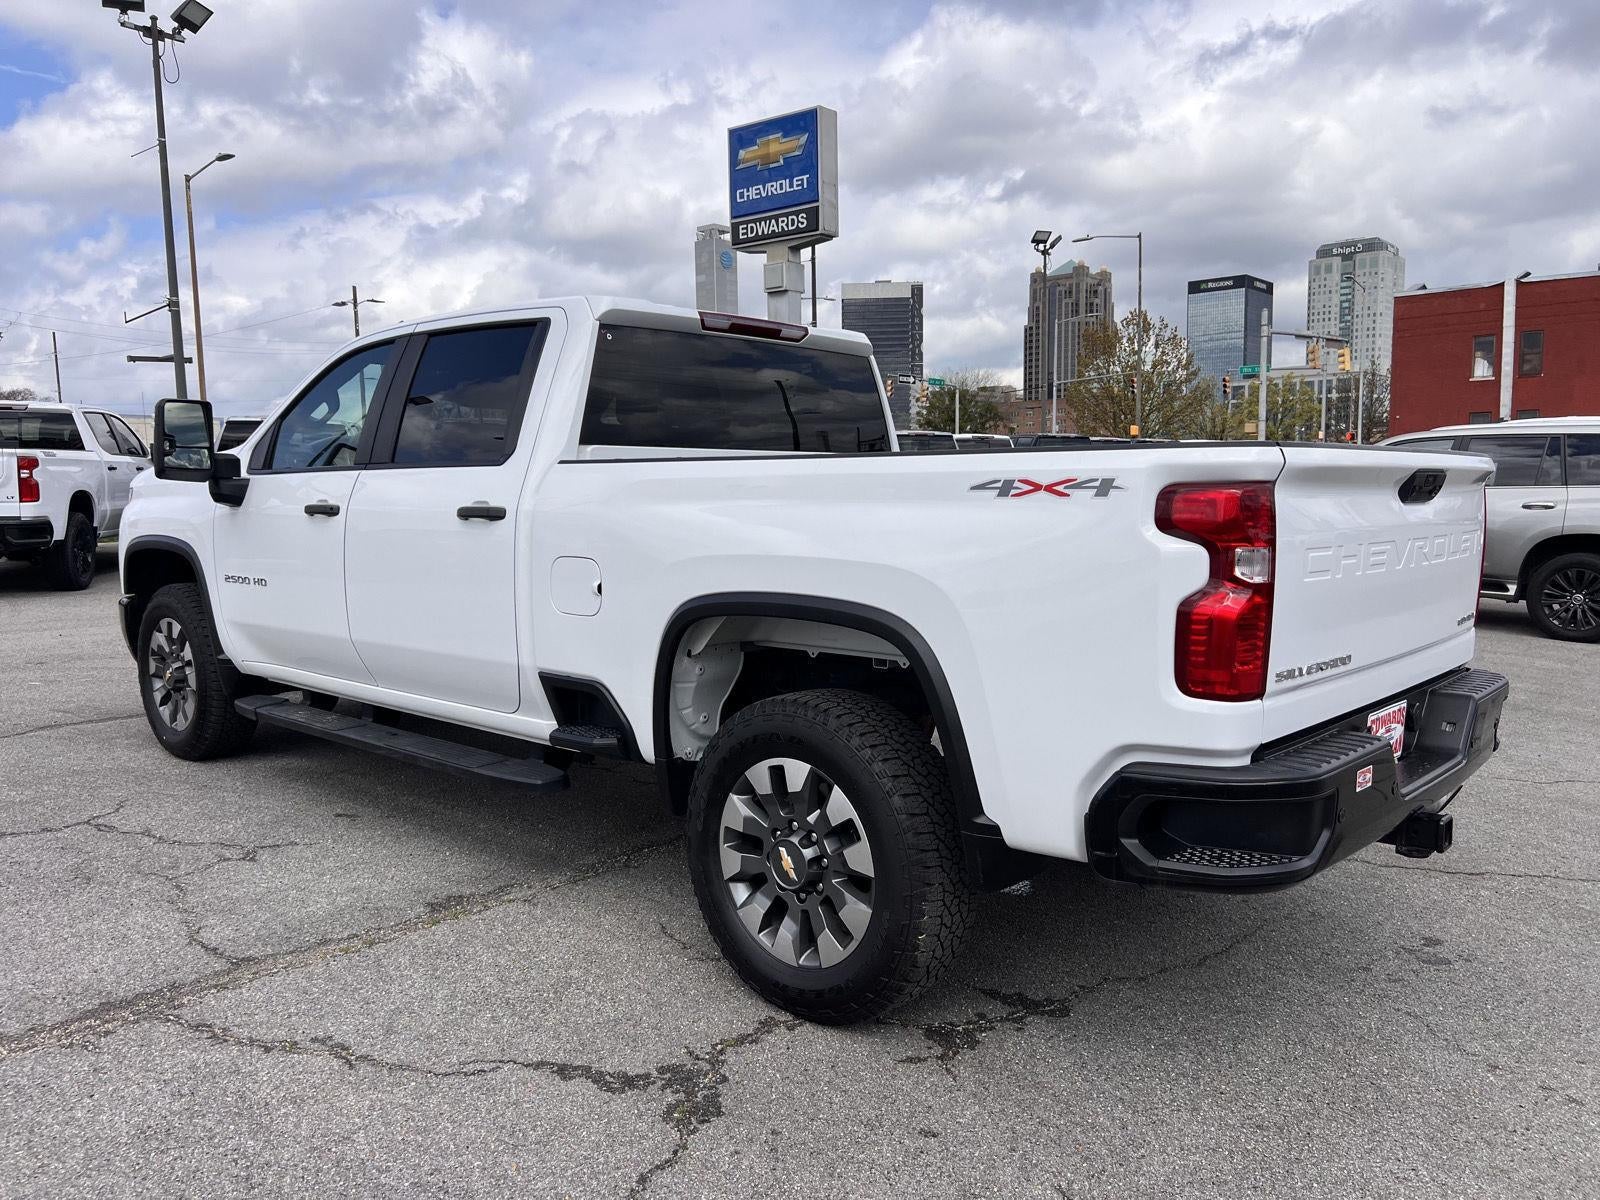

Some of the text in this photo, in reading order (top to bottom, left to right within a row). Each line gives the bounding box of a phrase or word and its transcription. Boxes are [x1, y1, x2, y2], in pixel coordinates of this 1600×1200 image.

[736, 174, 810, 203] CHEVROLET
[738, 213, 808, 239] EDWARDS
[1332, 245, 1355, 255] Shipt
[1207, 280, 1234, 289] REGIONS
[224, 574, 268, 587] 2500 HD
[1274, 654, 1352, 683] SILVERADO
